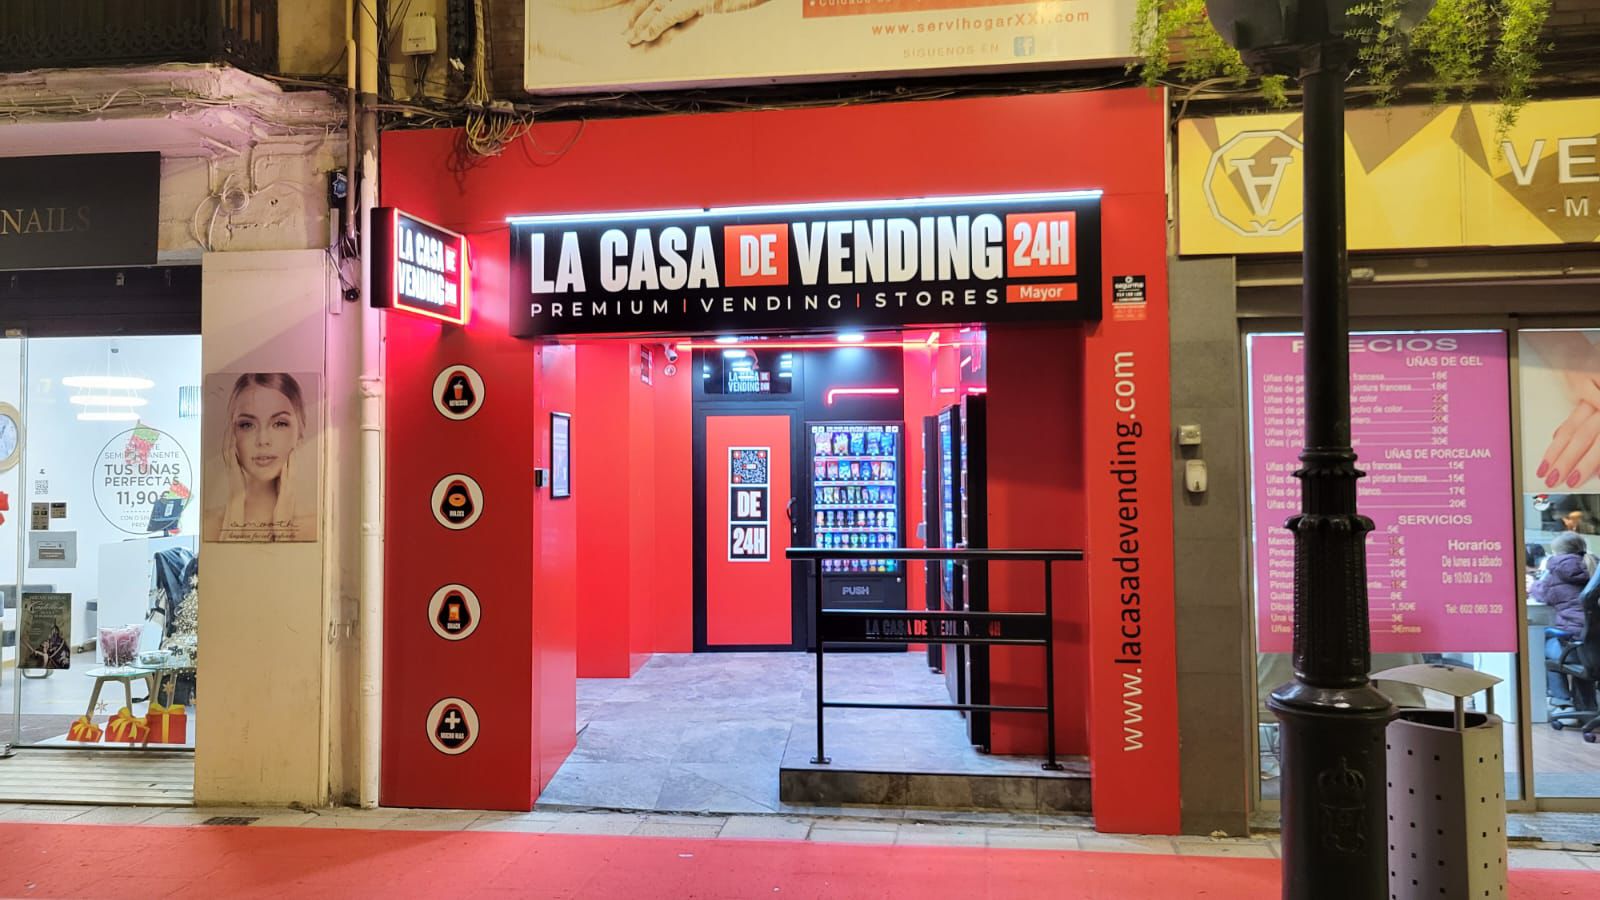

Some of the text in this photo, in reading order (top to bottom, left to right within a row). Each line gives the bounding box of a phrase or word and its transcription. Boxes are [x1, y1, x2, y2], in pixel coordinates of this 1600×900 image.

[0, 208, 91, 235] NAILS
[398, 226, 414, 262] LA
[415, 232, 445, 272] CASA
[531, 213, 1070, 294] LA CASA DE VENDING 24H
[398, 261, 445, 306] VENDING
[1019, 284, 1064, 301] Mayor
[530, 288, 999, 318] PREMIUM VENDING STORES
[1292, 337, 1458, 353] PECIOS
[1406, 355, 1483, 367] UÑAS DE GEL
[1385, 448, 1491, 459] UÑAS DE PORCELANA
[104, 460, 180, 475] TUS UÑAS
[104, 476, 180, 487] PERFECTAS
[1448, 486, 1465, 495] 17€
[737, 491, 762, 517] DE
[1449, 499, 1467, 508] 20€
[1398, 514, 1473, 526] SERVICIOS
[733, 527, 766, 555] 24H
[1447, 539, 1502, 551] Horarios
[1109, 351, 1143, 752] www.lacasadevending.com
[1441, 555, 1451, 567] De
[1442, 571, 1453, 584] De
[842, 586, 870, 596] PUSH
[914, 619, 928, 636] DE
